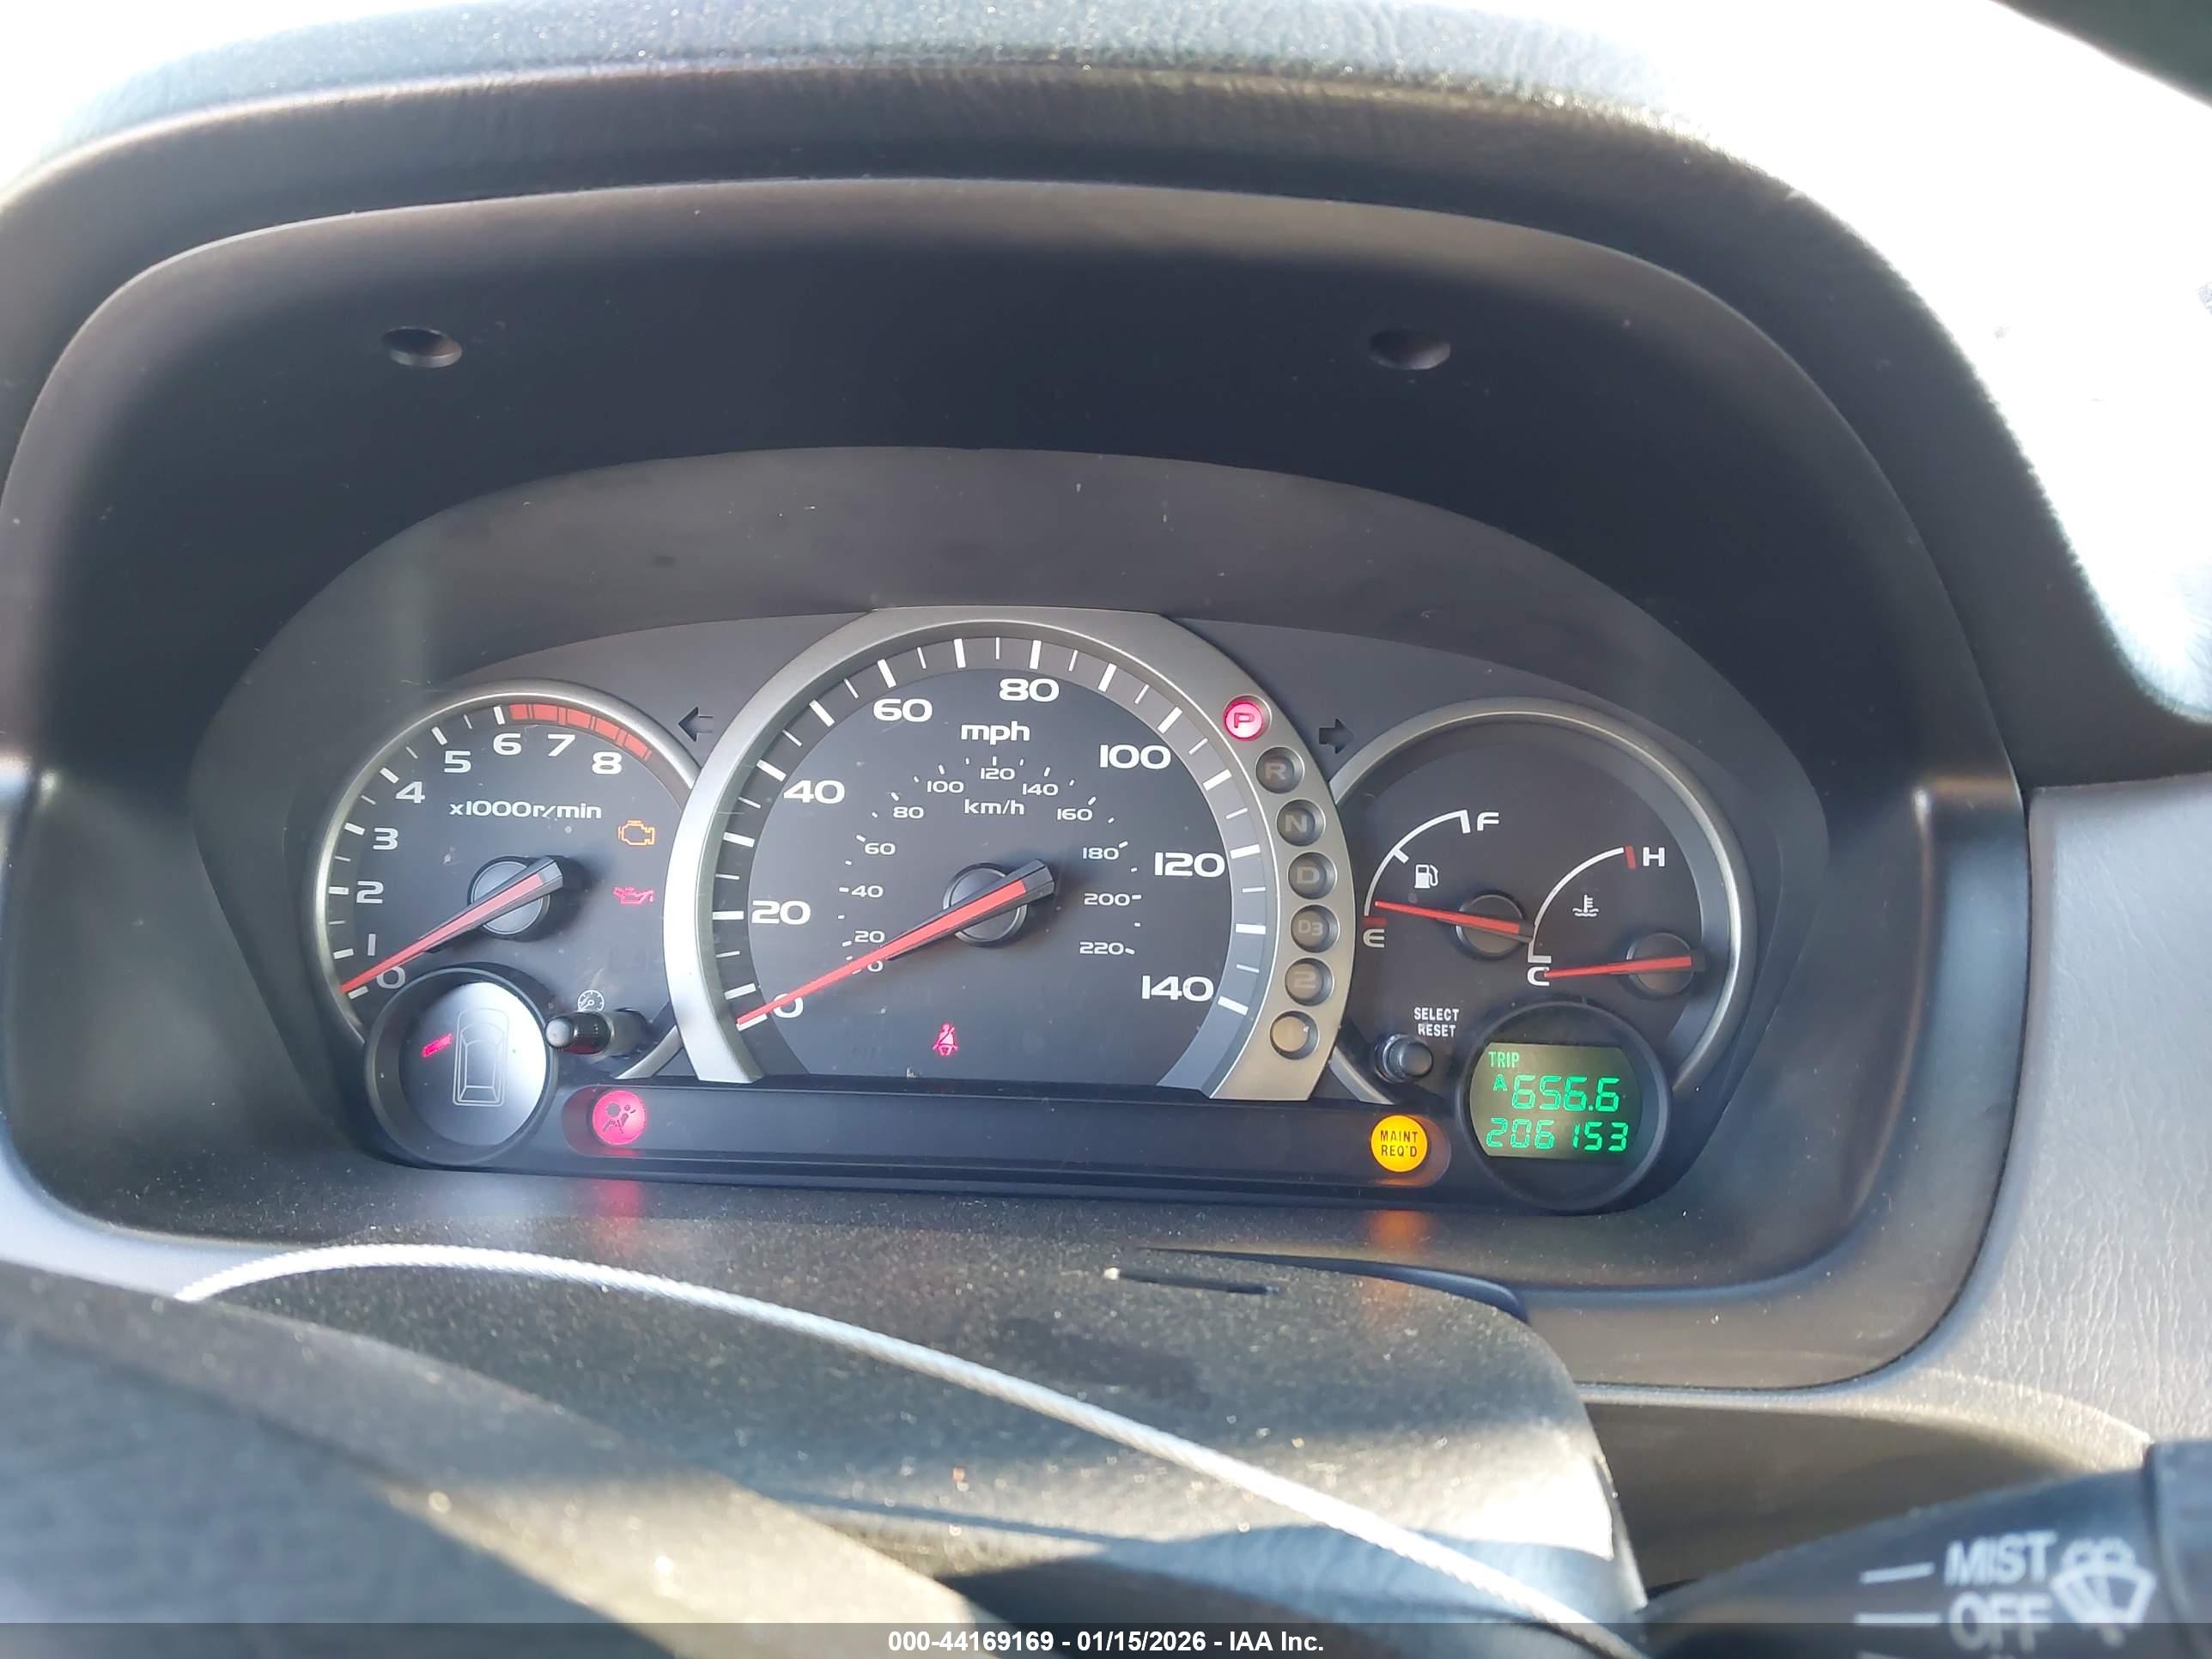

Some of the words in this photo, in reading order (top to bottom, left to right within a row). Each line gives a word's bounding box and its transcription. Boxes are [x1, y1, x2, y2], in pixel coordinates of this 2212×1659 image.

[999, 678, 1060, 702] 80
[872, 698, 933, 722] 60
[1234, 711, 1255, 728] P
[961, 720, 1030, 745] mph
[493, 733, 522, 756] 6
[547, 734, 576, 757] 7
[443, 750, 471, 773] 5
[592, 752, 623, 775] 8
[1099, 744, 1171, 769] 100
[980, 768, 1016, 781] 120
[1265, 762, 1286, 780] R
[396, 781, 426, 804] 4
[783, 780, 846, 804] 40
[927, 781, 964, 793] 100
[1023, 783, 1058, 797] 140
[449, 801, 602, 819] x1000r/min
[893, 806, 924, 819] 80
[963, 799, 1024, 817] km/h
[1056, 808, 1093, 821] 160
[1285, 814, 1308, 833] N
[1476, 811, 1500, 831] F
[372, 828, 399, 850] 3
[864, 842, 896, 856] 60
[1082, 848, 1120, 860] 180
[1642, 846, 1666, 867] H
[1154, 852, 1225, 878] 120
[1296, 866, 1321, 884] D
[356, 881, 384, 904] 2
[851, 885, 884, 898] 40
[1083, 893, 1131, 907] 200
[751, 901, 811, 925] 20
[854, 930, 885, 944] 20
[1297, 920, 1323, 936] D3
[368, 933, 376, 957] 1
[1079, 941, 1124, 956] 220
[1363, 928, 1385, 949] E
[376, 966, 406, 989] 0
[1293, 970, 1319, 989] 2
[1528, 967, 1550, 987] C
[1141, 975, 1214, 1002] 140
[773, 993, 804, 1018] 0
[1413, 1007, 1460, 1022] SELECT
[1417, 1023, 1456, 1038] RESET
[1488, 1051, 1520, 1067] TRIP
[1492, 1074, 1508, 1091] A
[1511, 1074, 1621, 1113] 656.6
[1380, 1131, 1419, 1143] MAINT
[1381, 1144, 1418, 1158] REQ'D
[1943, 1529, 2057, 1586] MIST
[1948, 1591, 2052, 1652] OFF
